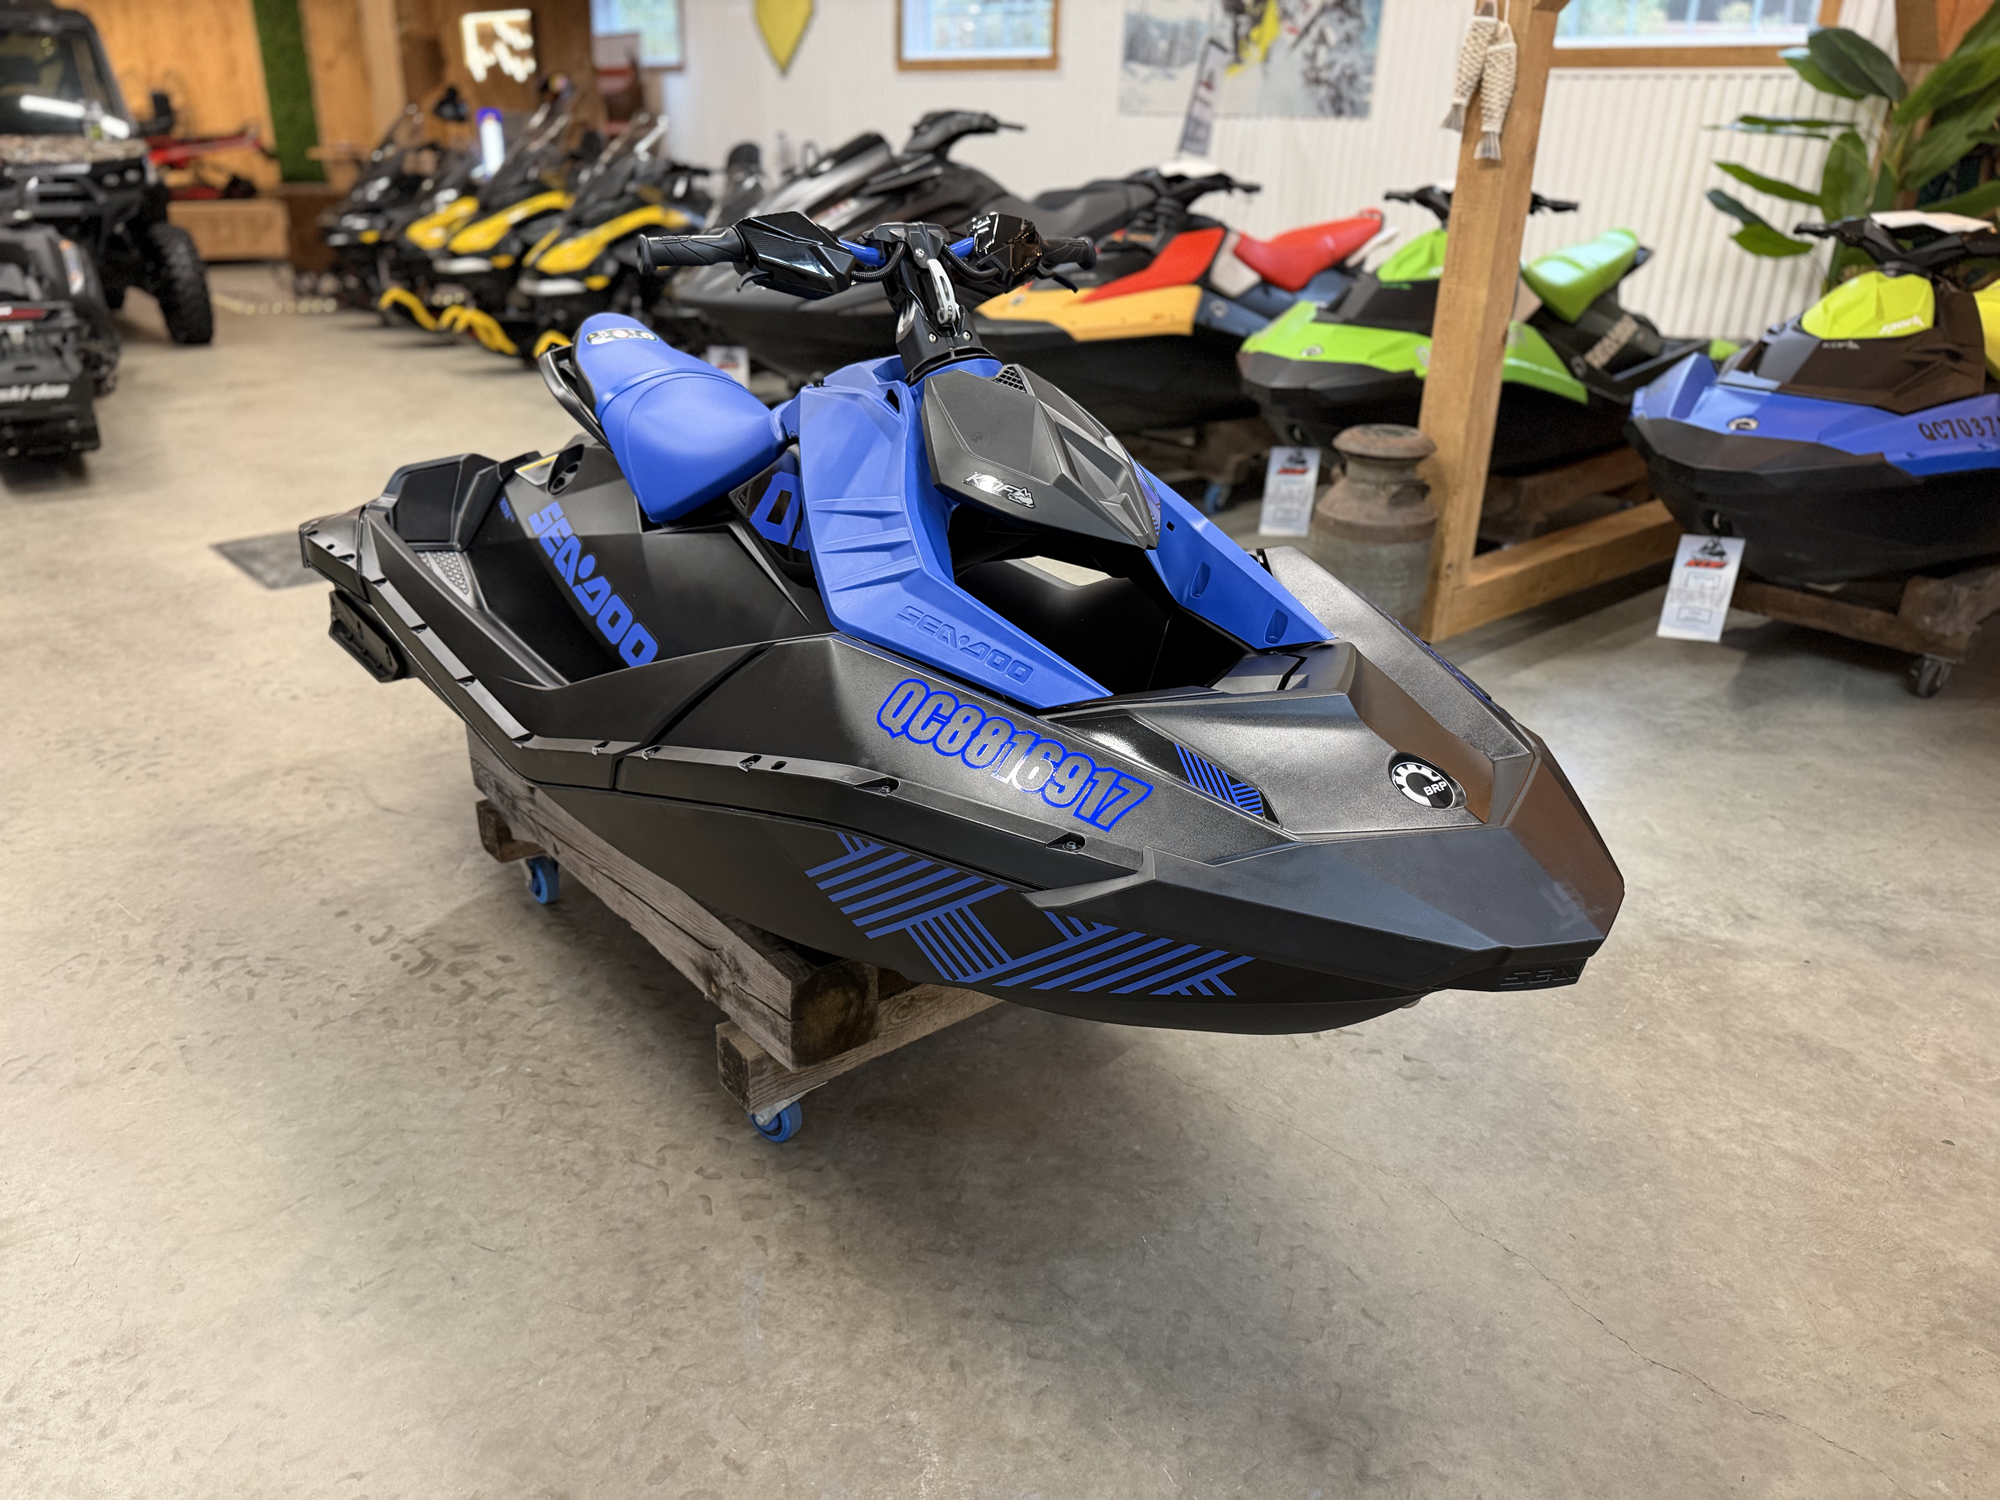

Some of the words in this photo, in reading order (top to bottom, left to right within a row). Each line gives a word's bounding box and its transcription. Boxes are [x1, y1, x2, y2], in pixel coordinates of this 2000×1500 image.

[1918, 415, 2000, 441] QC7037
[876, 678, 1154, 833] QC8816917
[1423, 780, 1448, 797] BRP
[1499, 963, 1586, 986] SEA
